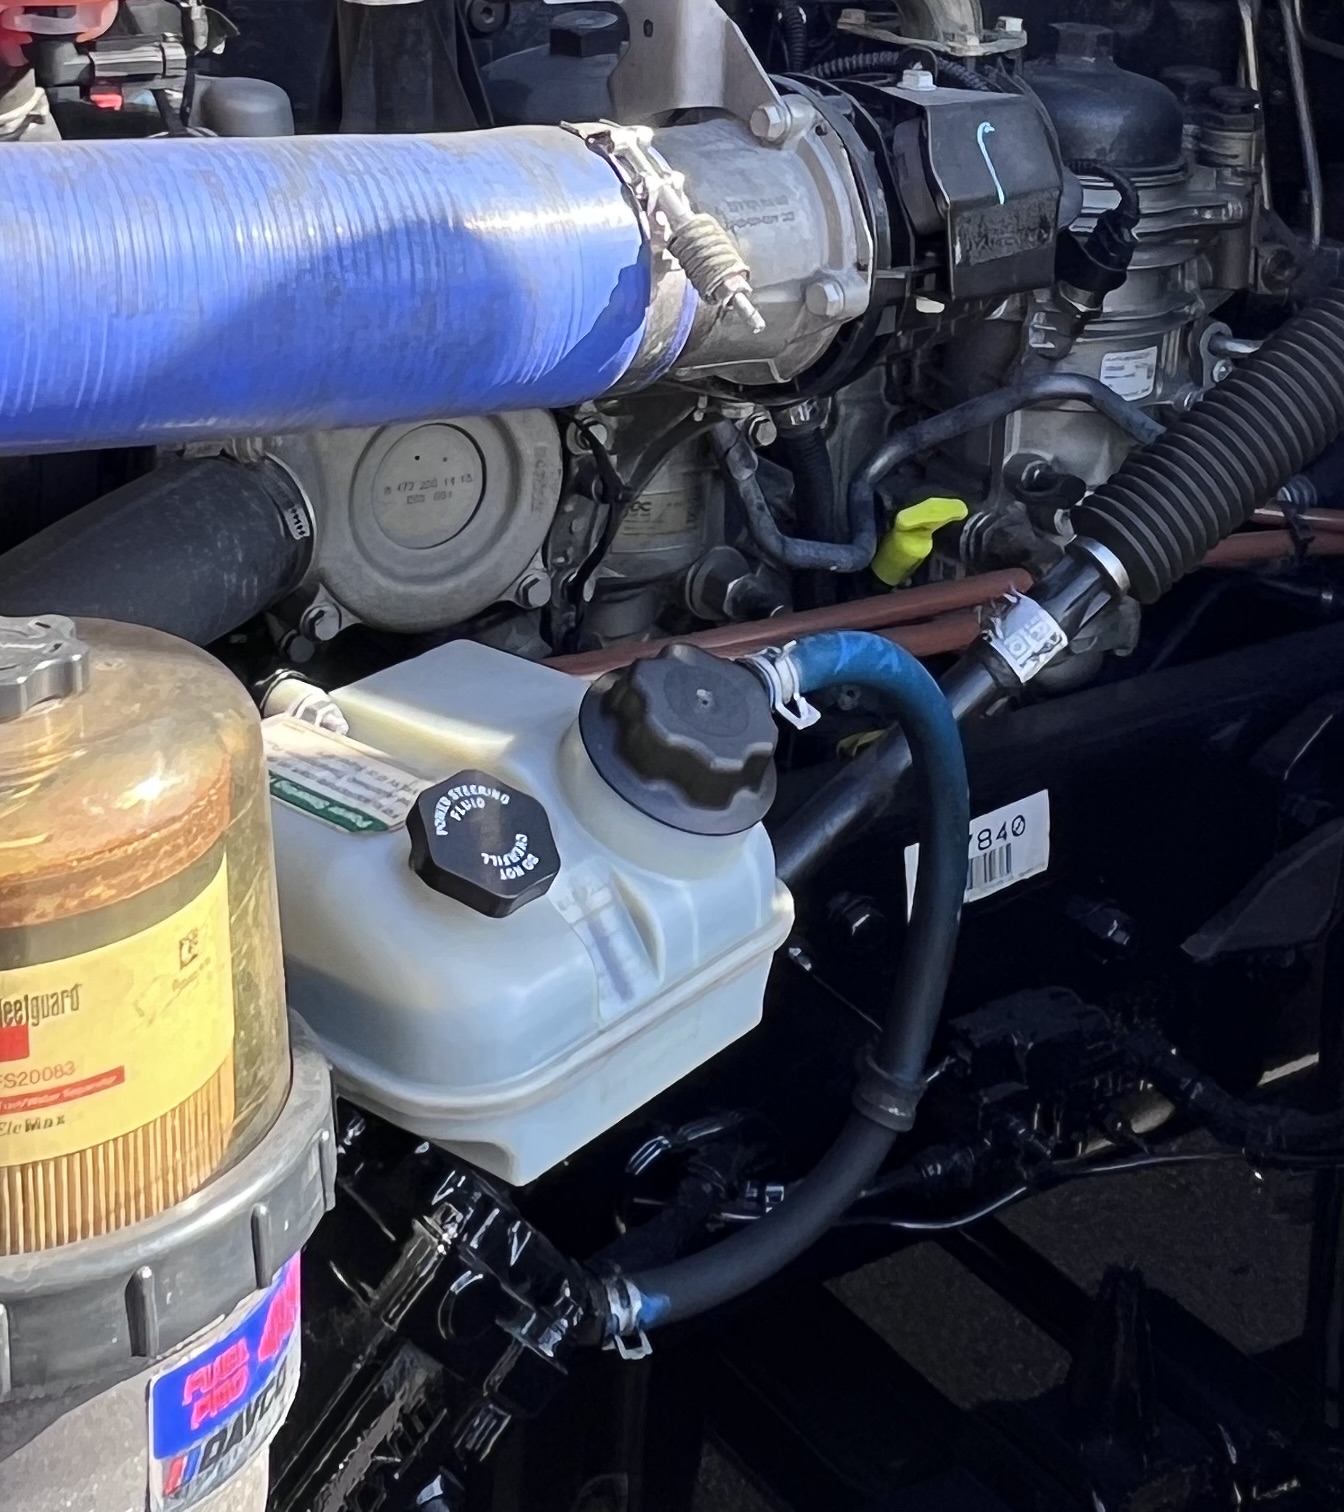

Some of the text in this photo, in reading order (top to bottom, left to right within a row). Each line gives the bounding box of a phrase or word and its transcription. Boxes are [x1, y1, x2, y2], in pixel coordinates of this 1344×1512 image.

[447, 784, 511, 805] STEERING
[450, 797, 486, 821] FLUID
[968, 814, 1026, 851] 840
[499, 866, 525, 880] NOT
[197, 1355, 288, 1474] DAVCO
